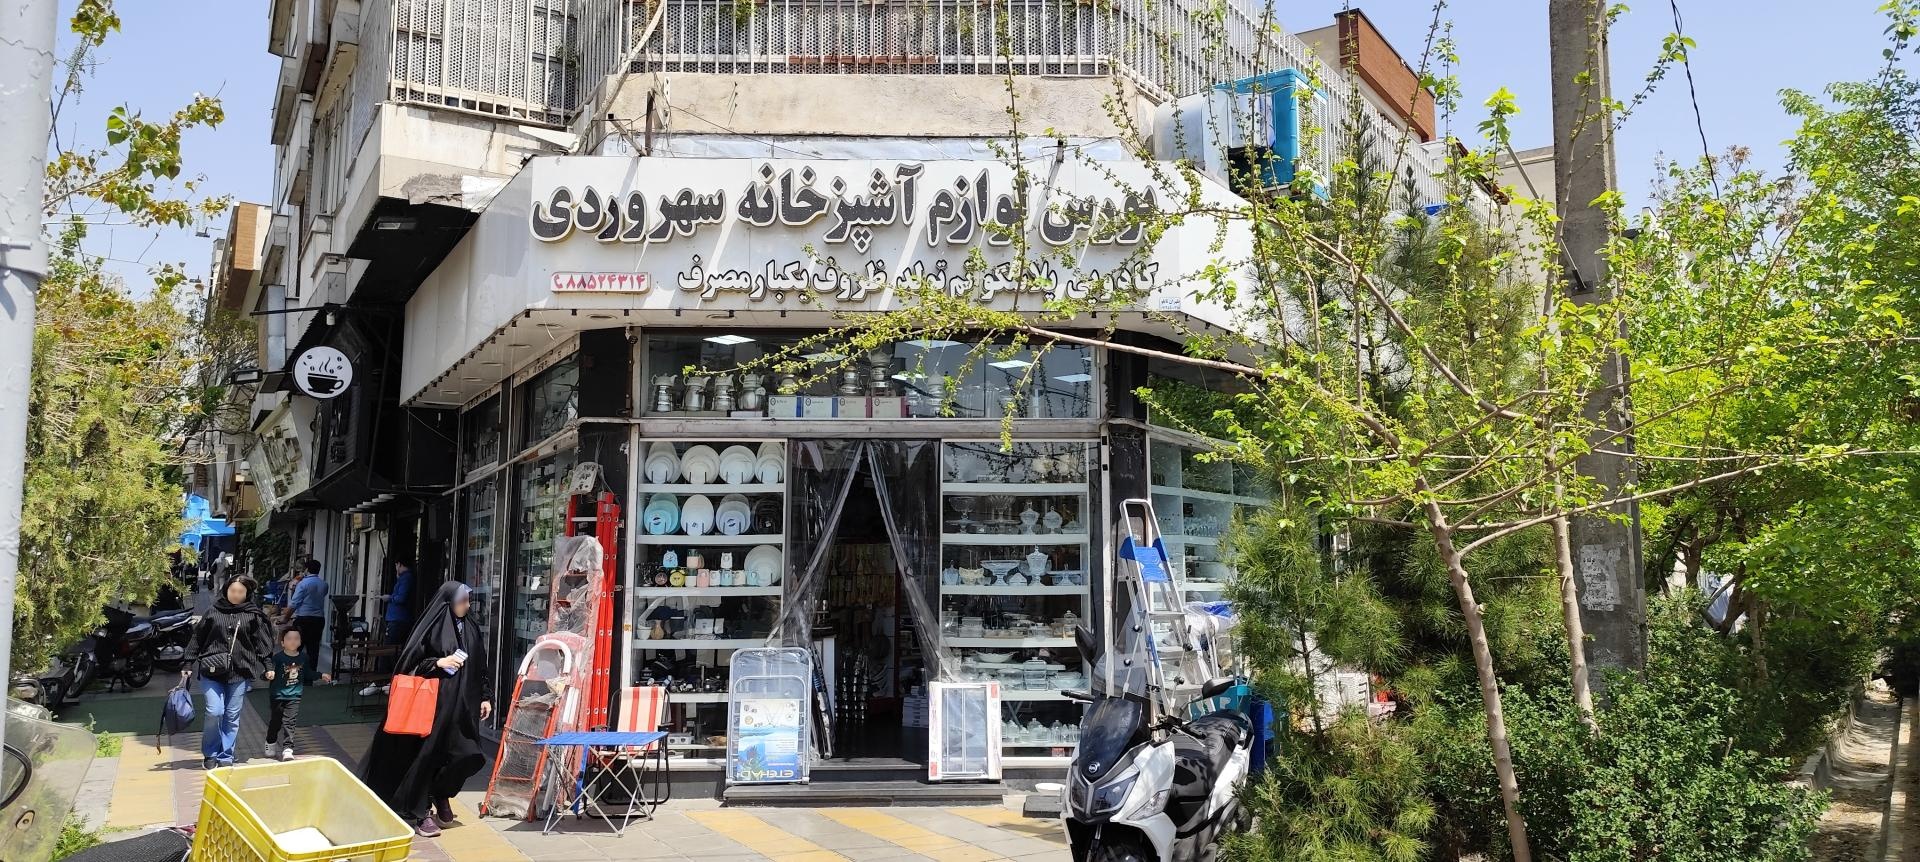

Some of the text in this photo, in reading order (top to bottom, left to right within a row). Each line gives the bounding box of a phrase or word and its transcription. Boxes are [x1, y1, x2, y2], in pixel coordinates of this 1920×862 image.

[529, 185, 727, 243] سهروردی
[737, 161, 926, 254] آشپزخانه
[927, 166, 1031, 248] لوازم
[566, 273, 646, 290] ۸۸۵۲۴۳۱۴
[812, 256, 888, 301] ظروف
